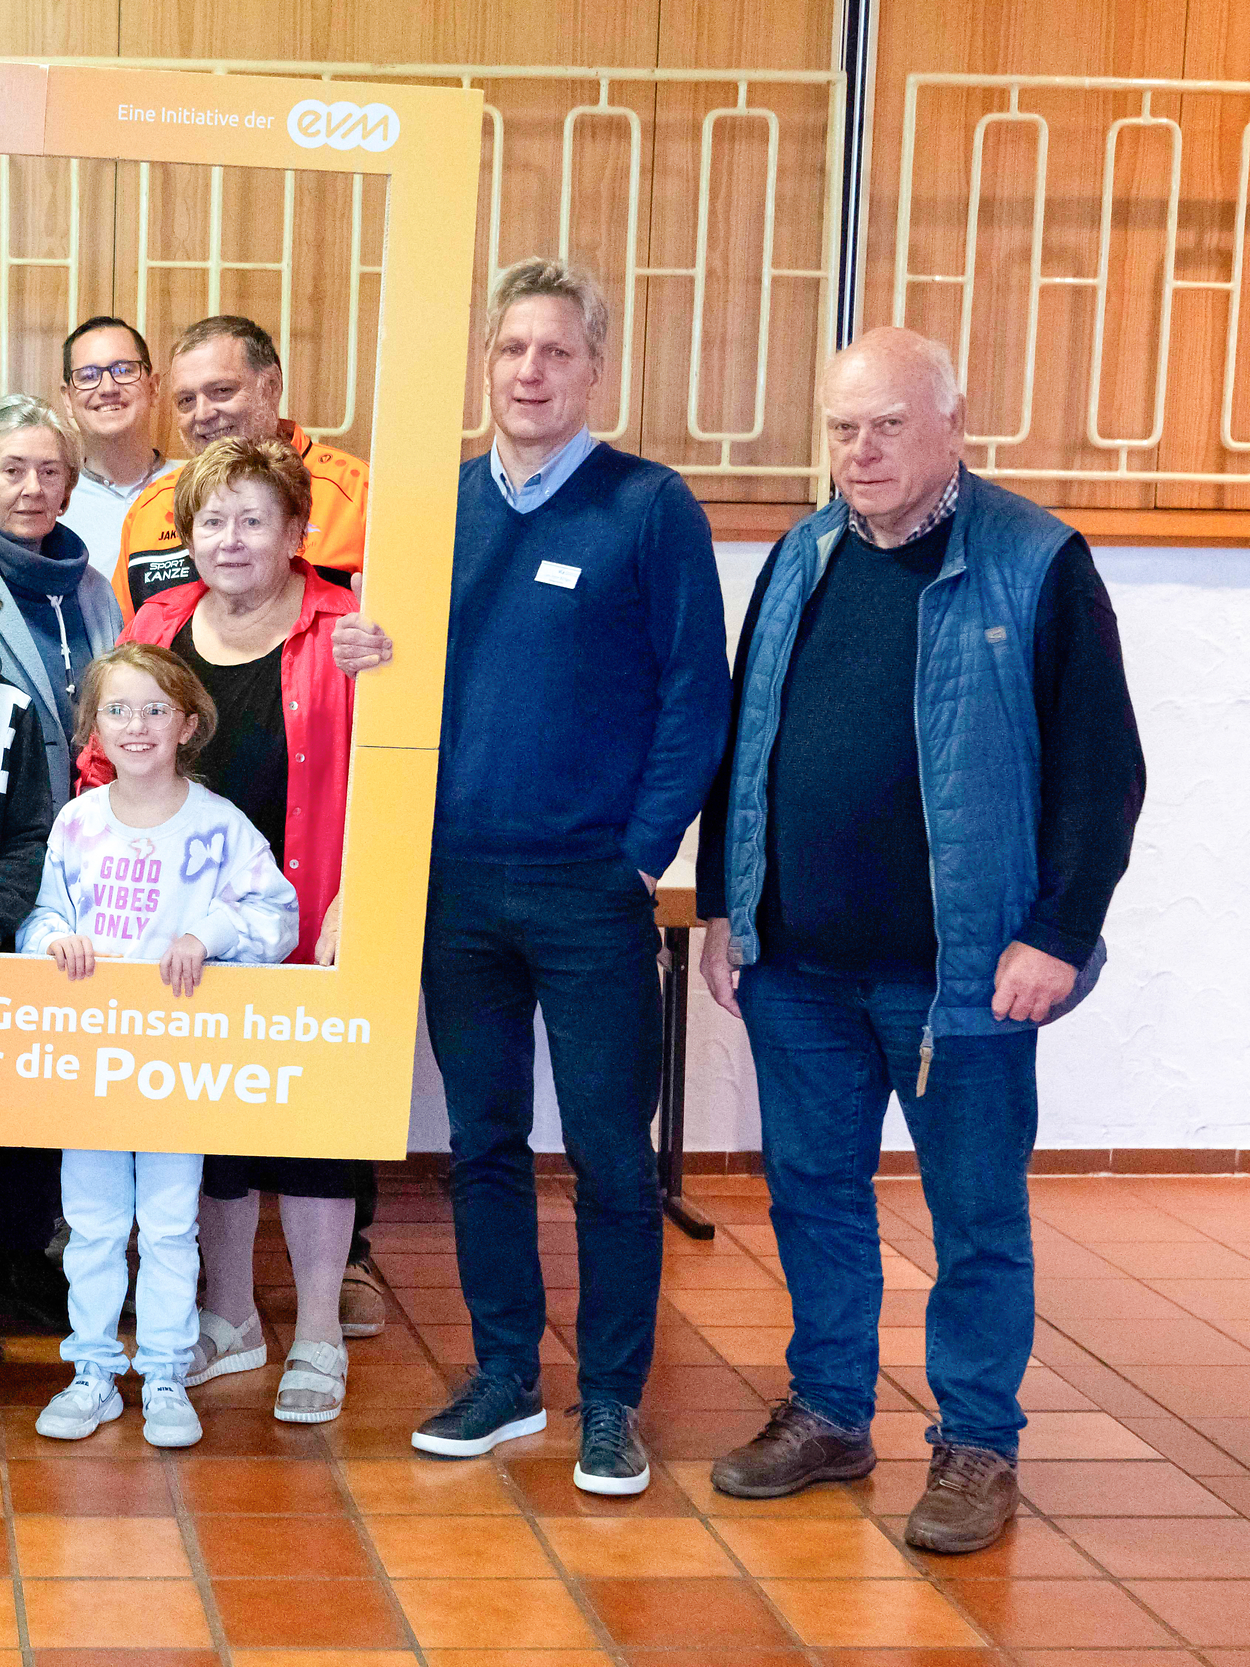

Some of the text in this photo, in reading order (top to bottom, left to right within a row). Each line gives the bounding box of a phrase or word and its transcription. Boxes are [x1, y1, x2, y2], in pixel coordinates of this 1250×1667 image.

[117, 104, 276, 129] Eine Initiative der
[294, 107, 391, 144] evm
[158, 530, 178, 540] JAK
[144, 566, 190, 583] KANZE
[149, 558, 185, 571] SPORT
[100, 855, 162, 884] GOOD
[93, 883, 161, 913] VIBES
[94, 912, 150, 940] ONLY
[243, 1004, 371, 1044] haben
[15, 1042, 80, 1080] die
[94, 1047, 303, 1104] Power
